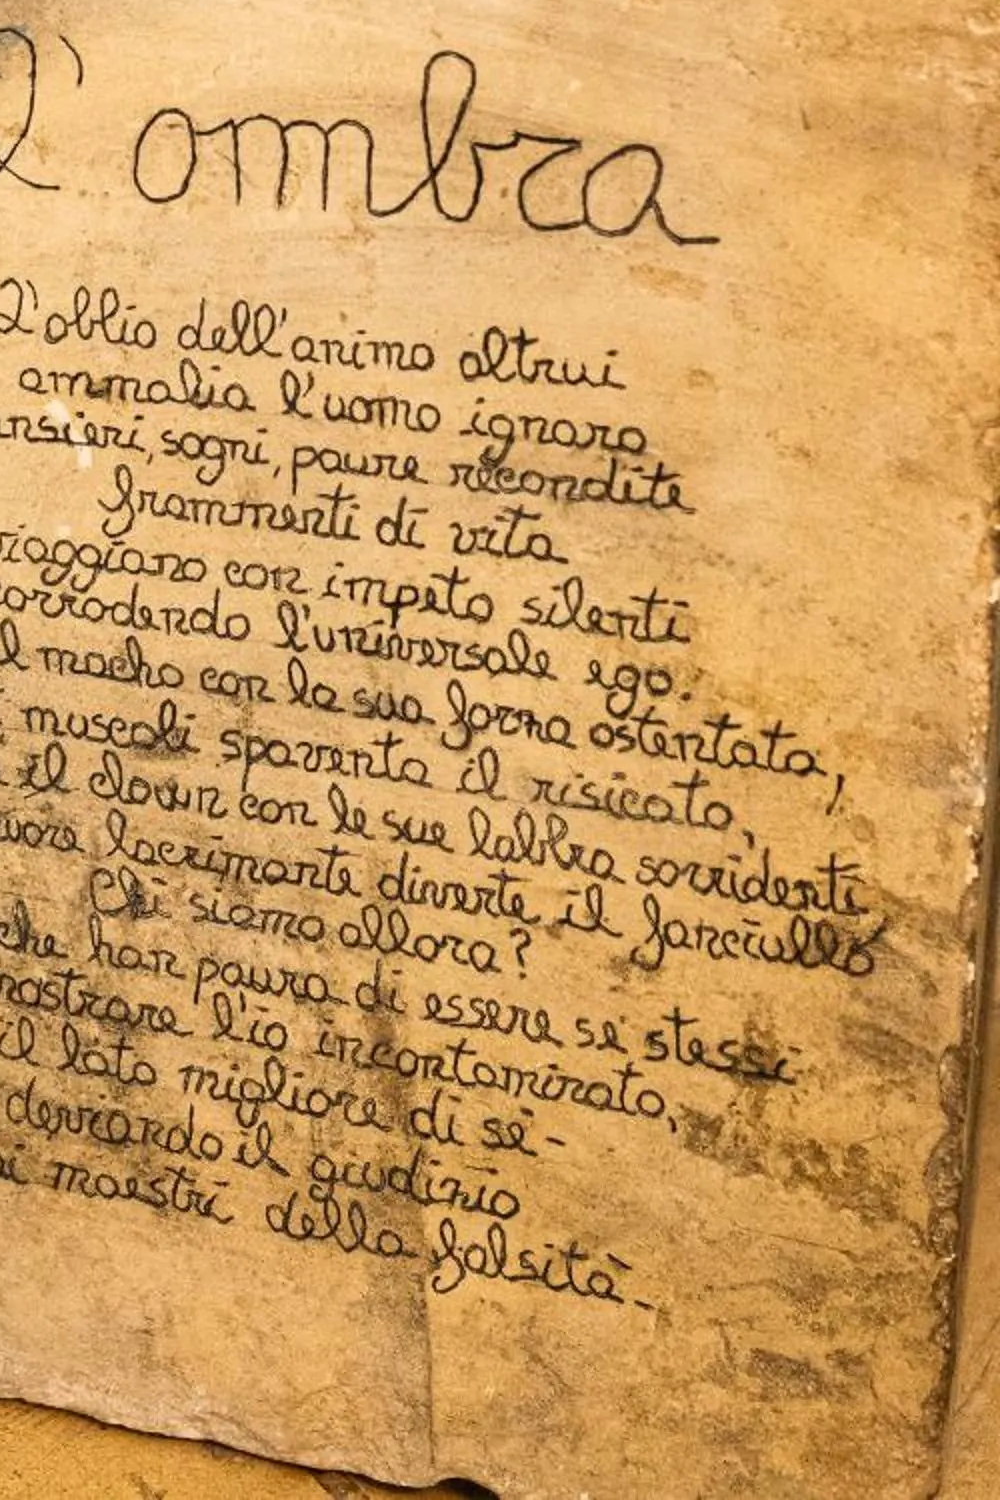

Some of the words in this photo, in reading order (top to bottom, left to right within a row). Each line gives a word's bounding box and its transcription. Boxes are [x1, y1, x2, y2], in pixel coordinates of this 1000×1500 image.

[459, 325, 626, 390] altrui
[19, 357, 256, 412] ammalia
[459, 396, 648, 465] ignaro
[99, 463, 361, 541] frammenti
[376, 497, 429, 549] di
[449, 504, 569, 565] vita
[161, 428, 282, 487] sogni,
[292, 444, 428, 496] paure
[449, 457, 697, 514] recondite
[224, 560, 308, 596] con
[321, 561, 495, 629] impeto
[520, 575, 691, 644] silenti
[37, 635, 185, 690] macho
[200, 666, 276, 702] con
[287, 656, 346, 713] la
[352, 687, 436, 726] sua
[589, 704, 846, 816] ostentata,
[584, 659, 692, 720] ego.
[20, 698, 201, 755] muscoli
[218, 729, 434, 793] spaventa
[456, 745, 506, 801] il
[17, 740, 80, 799] il
[89, 750, 229, 820] clown
[239, 792, 318, 827] con
[327, 782, 376, 841] le
[382, 808, 455, 854] sue
[467, 804, 627, 885] labbra
[635, 846, 870, 916] sorridenti
[107, 807, 362, 898] lacrimante
[377, 850, 541, 925] diverte
[556, 881, 624, 938] il
[188, 886, 326, 943] siamo
[87, 911, 186, 980] han
[193, 956, 350, 1005] paura
[355, 958, 408, 1014] di
[421, 992, 563, 1050] essere
[58, 1021, 156, 1086] lato
[178, 1055, 394, 1132] migliore
[410, 1087, 465, 1148] di
[313, 1018, 677, 1134] incontaminato,
[232, 1120, 291, 1179] il
[51, 1161, 235, 1225] maestri
[265, 1190, 419, 1259] della
